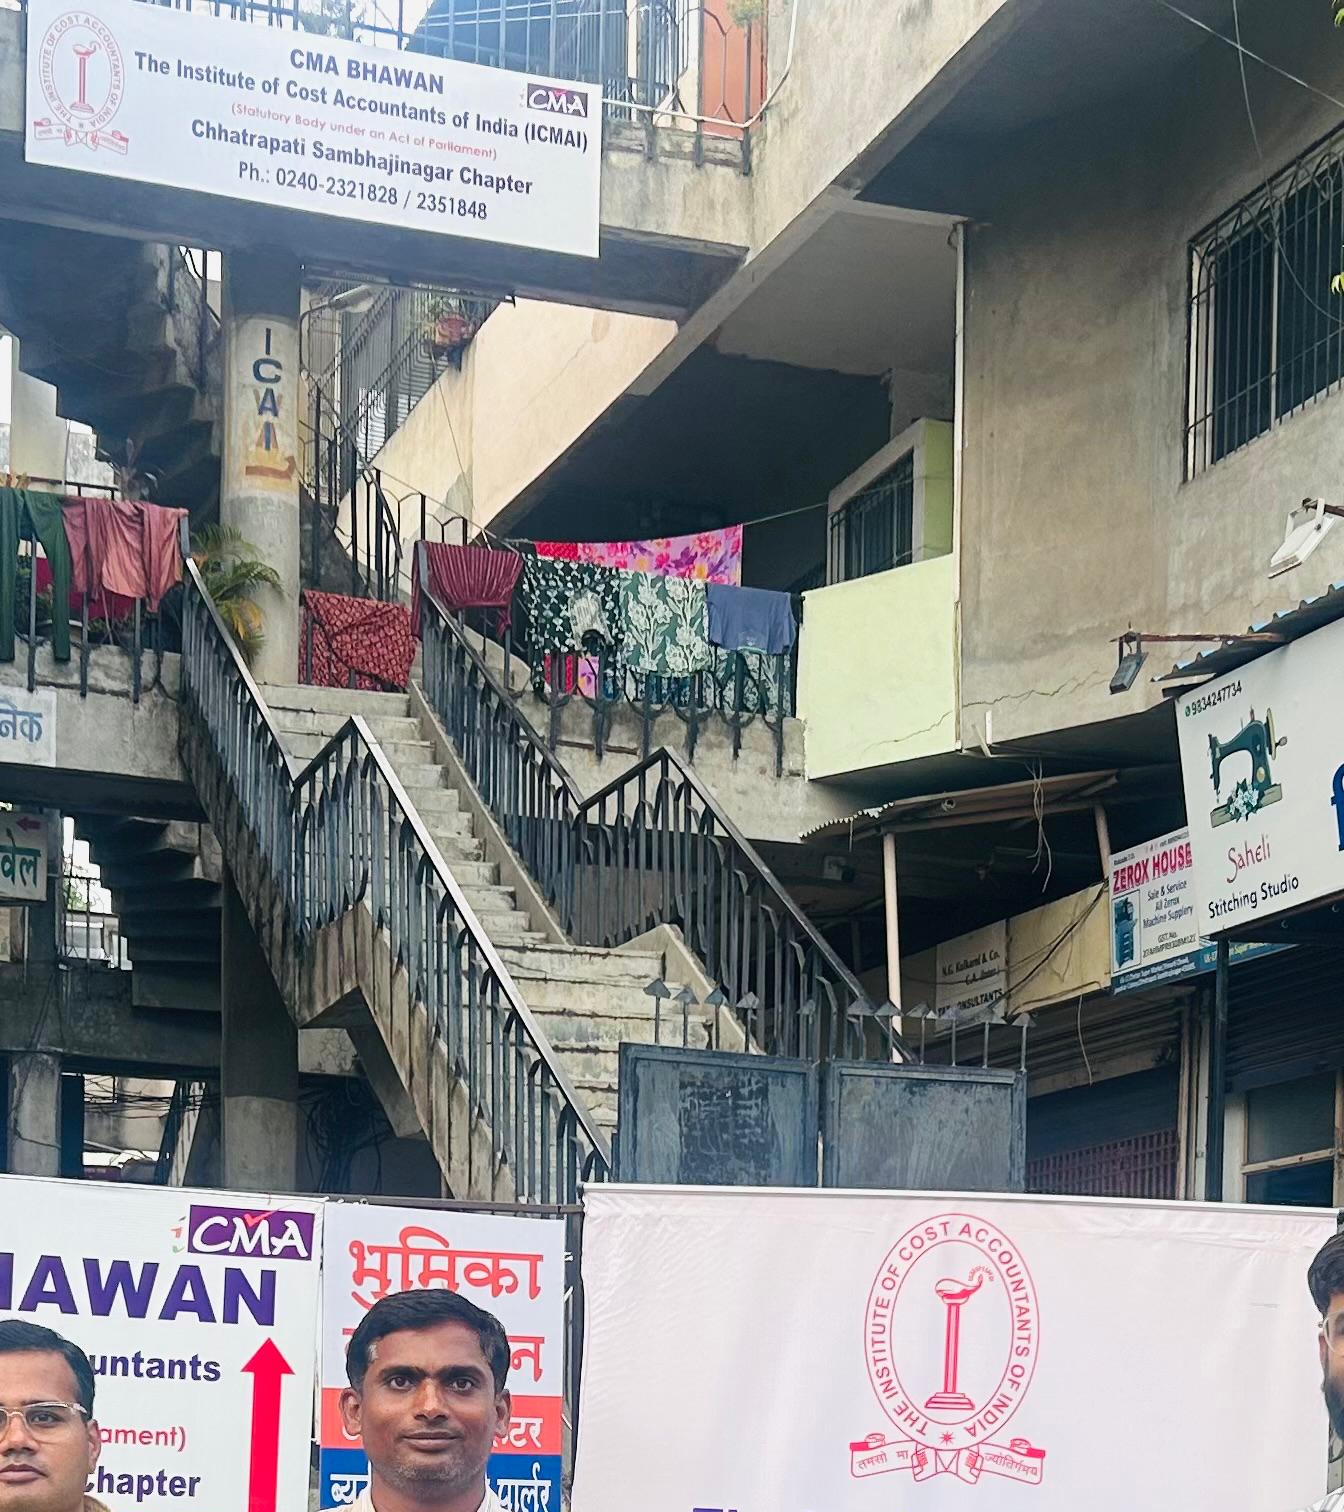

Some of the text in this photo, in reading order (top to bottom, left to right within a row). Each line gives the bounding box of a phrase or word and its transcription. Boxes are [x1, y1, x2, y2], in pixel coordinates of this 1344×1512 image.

[289, 48, 444, 95] CMA BHAWAN
[134, 50, 589, 154] The Institute of Cost Accountants of India (ICMAI)
[529, 89, 587, 117] CMA
[231, 103, 498, 161] (Statutory Body under an Act of Parliament)
[191, 119, 533, 196] Chhatrapati Sambhajinagar Chapter
[275, 167, 398, 206] 0240-2321828
[403, 190, 412, 209] /
[416, 192, 488, 220] 2351848
[1113, 841, 1193, 894] ZEROX HOUSE
[1226, 834, 1272, 883] Saheli
[1208, 873, 1299, 919] Stitching Studio
[192, 1215, 309, 1258] CMA
[899, 1221, 951, 1262] COST
[881, 1264, 900, 1292] OF
[958, 1223, 1032, 1358] ACCOUNTANTS
[90, 1351, 222, 1382] untants
[871, 1298, 900, 1401] INSTITUTE
[1007, 1364, 1025, 1391] OF
[892, 1403, 929, 1437] THE
[963, 1392, 1013, 1438] INDIA
[98, 1427, 186, 1451] ament)
